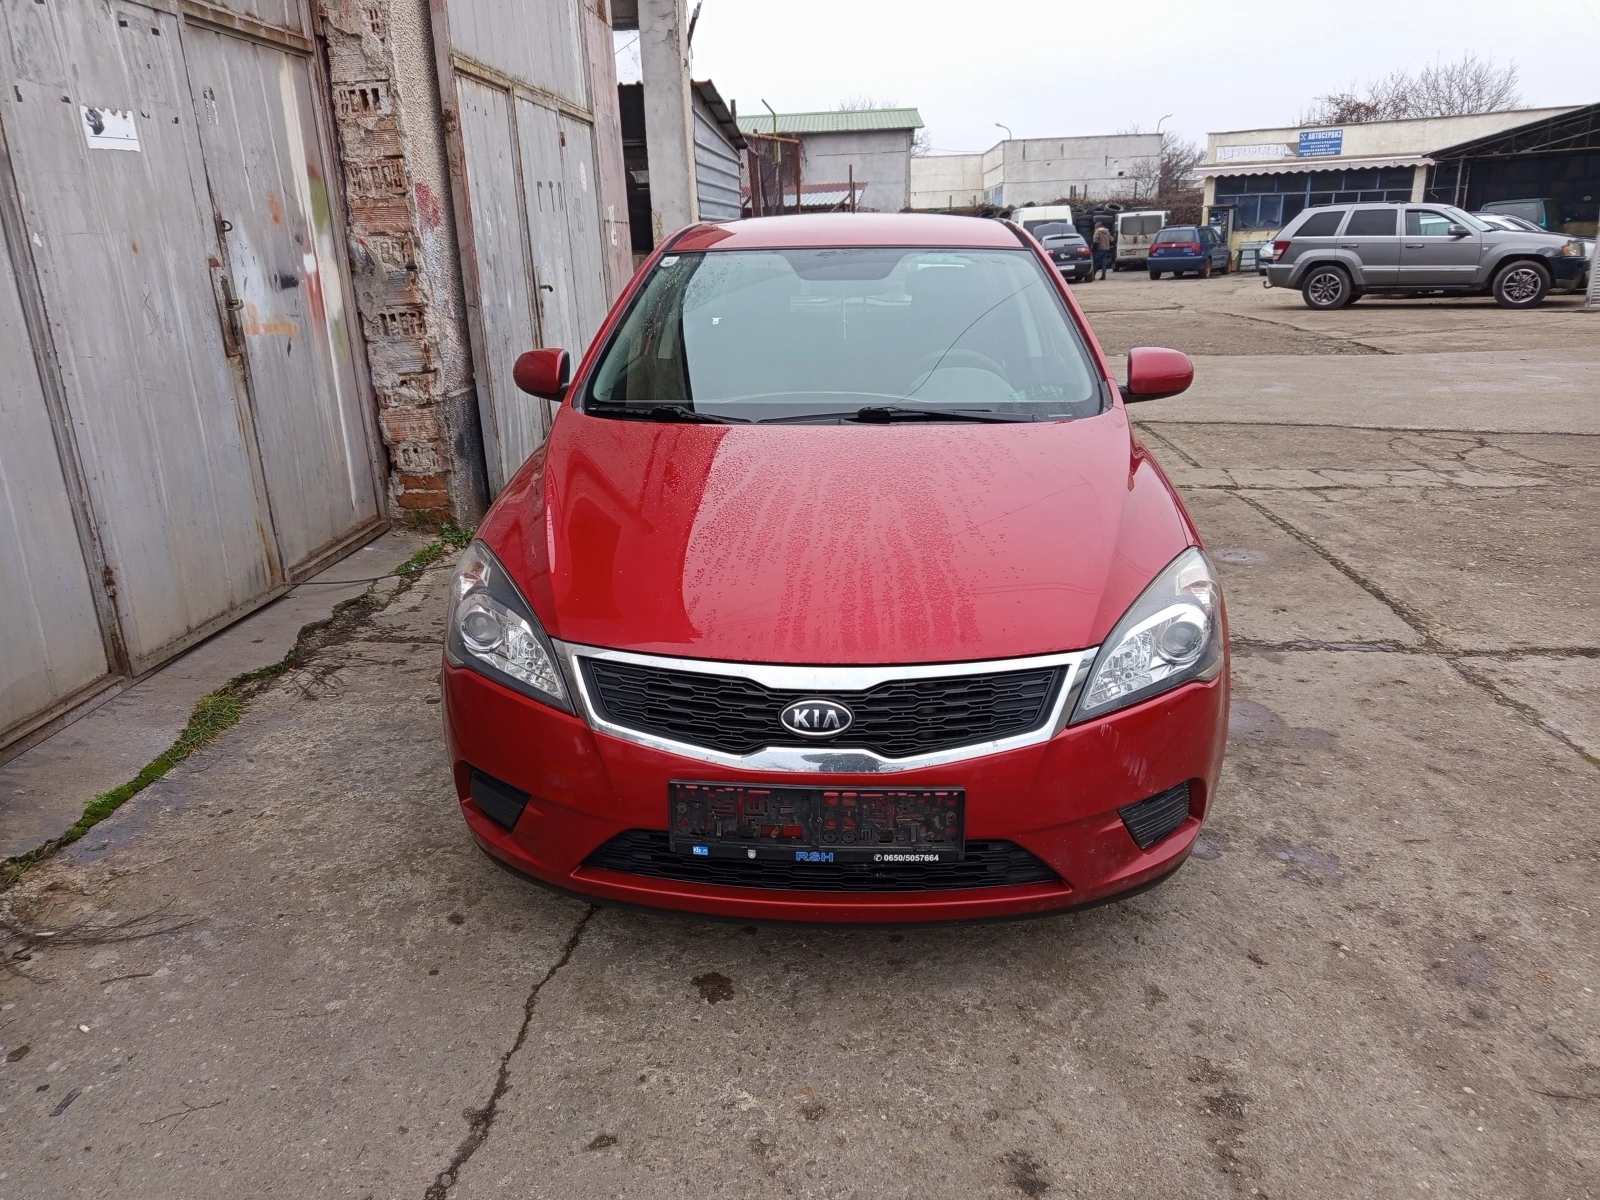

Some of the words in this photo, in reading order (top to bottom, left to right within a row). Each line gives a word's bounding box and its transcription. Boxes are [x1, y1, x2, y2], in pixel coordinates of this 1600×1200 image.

[1308, 130, 1342, 140] АВТОСЕРВИЗ
[793, 709, 840, 728] KIA
[796, 852, 834, 862] RSH
[884, 854, 939, 862] 0650/5057664
